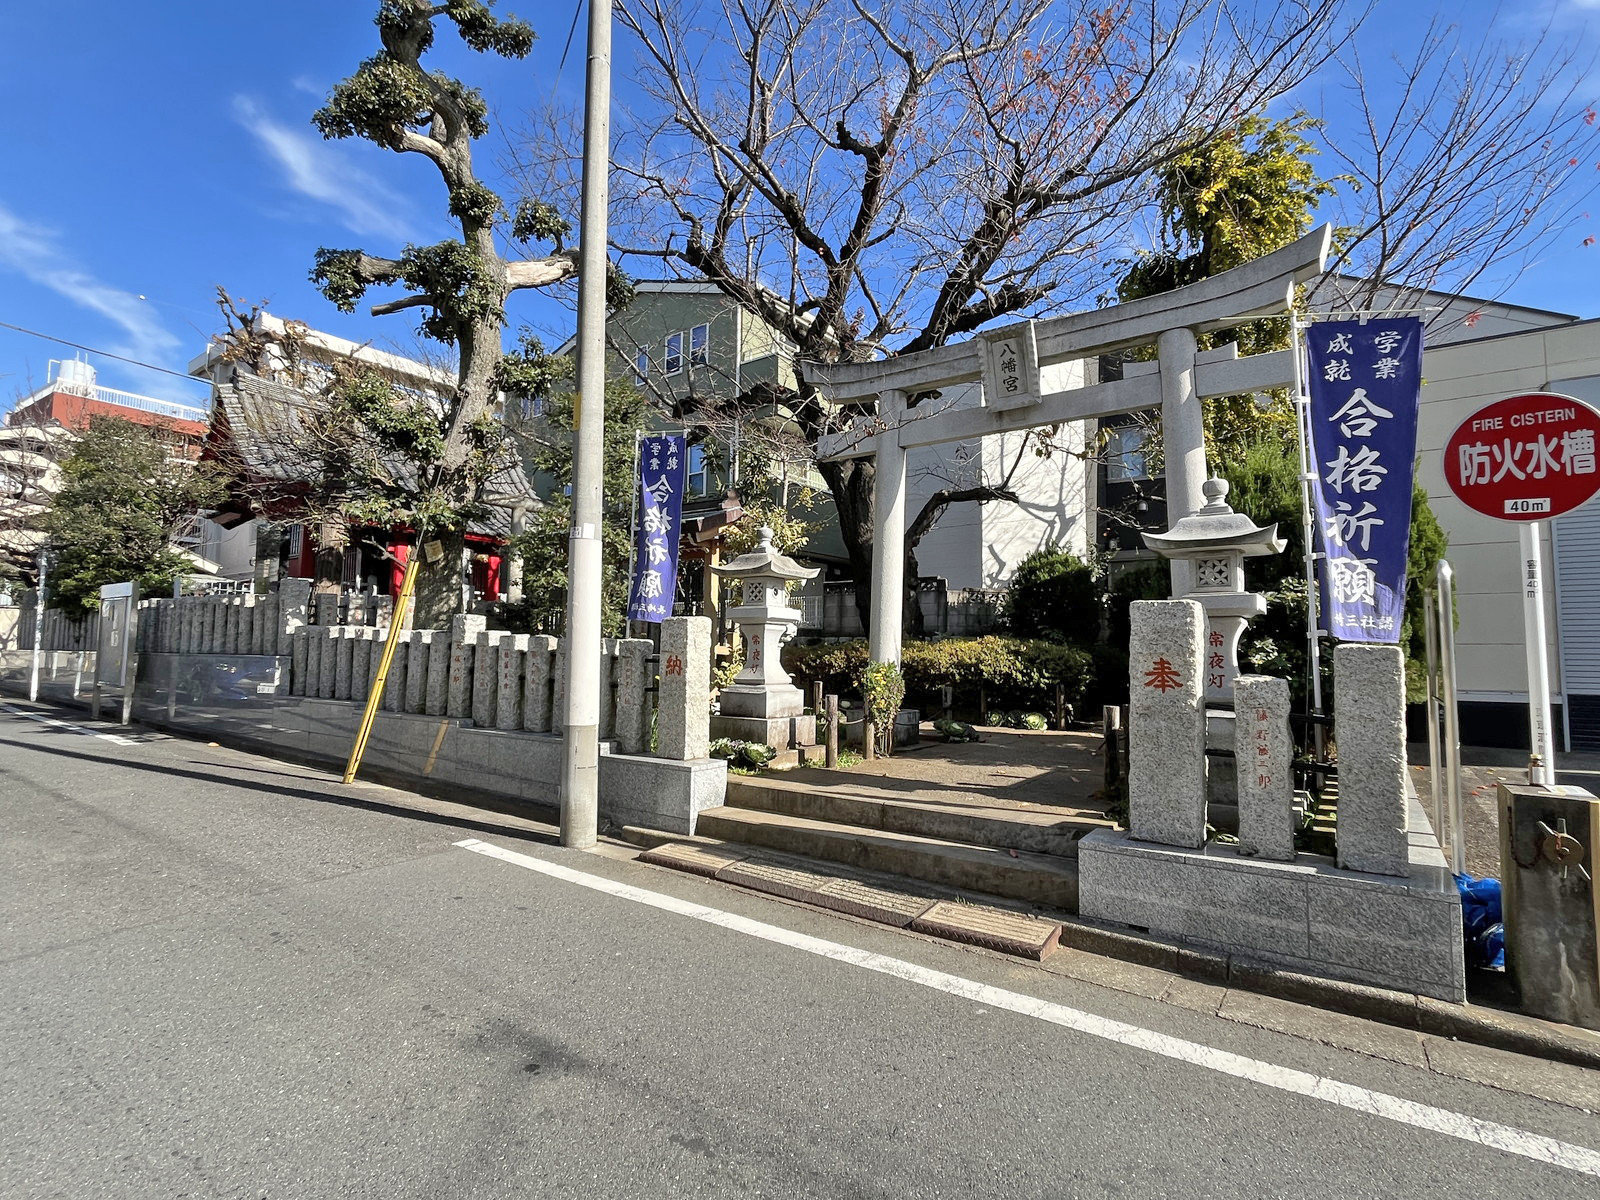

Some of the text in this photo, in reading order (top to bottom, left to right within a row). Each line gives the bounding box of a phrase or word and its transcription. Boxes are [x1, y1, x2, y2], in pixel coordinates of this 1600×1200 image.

[1000, 343, 1019, 393] 八幡宮
[1324, 333, 1354, 382] 成就
[1371, 331, 1402, 379] 学業
[1472, 408, 1576, 432] FIRE CISTERN
[1458, 429, 1597, 487] 防火水槽
[1325, 387, 1394, 606] 合格祈願
[665, 655, 683, 677] 納
[1144, 657, 1184, 694] 奉
[1207, 631, 1226, 689] 常夜灯
